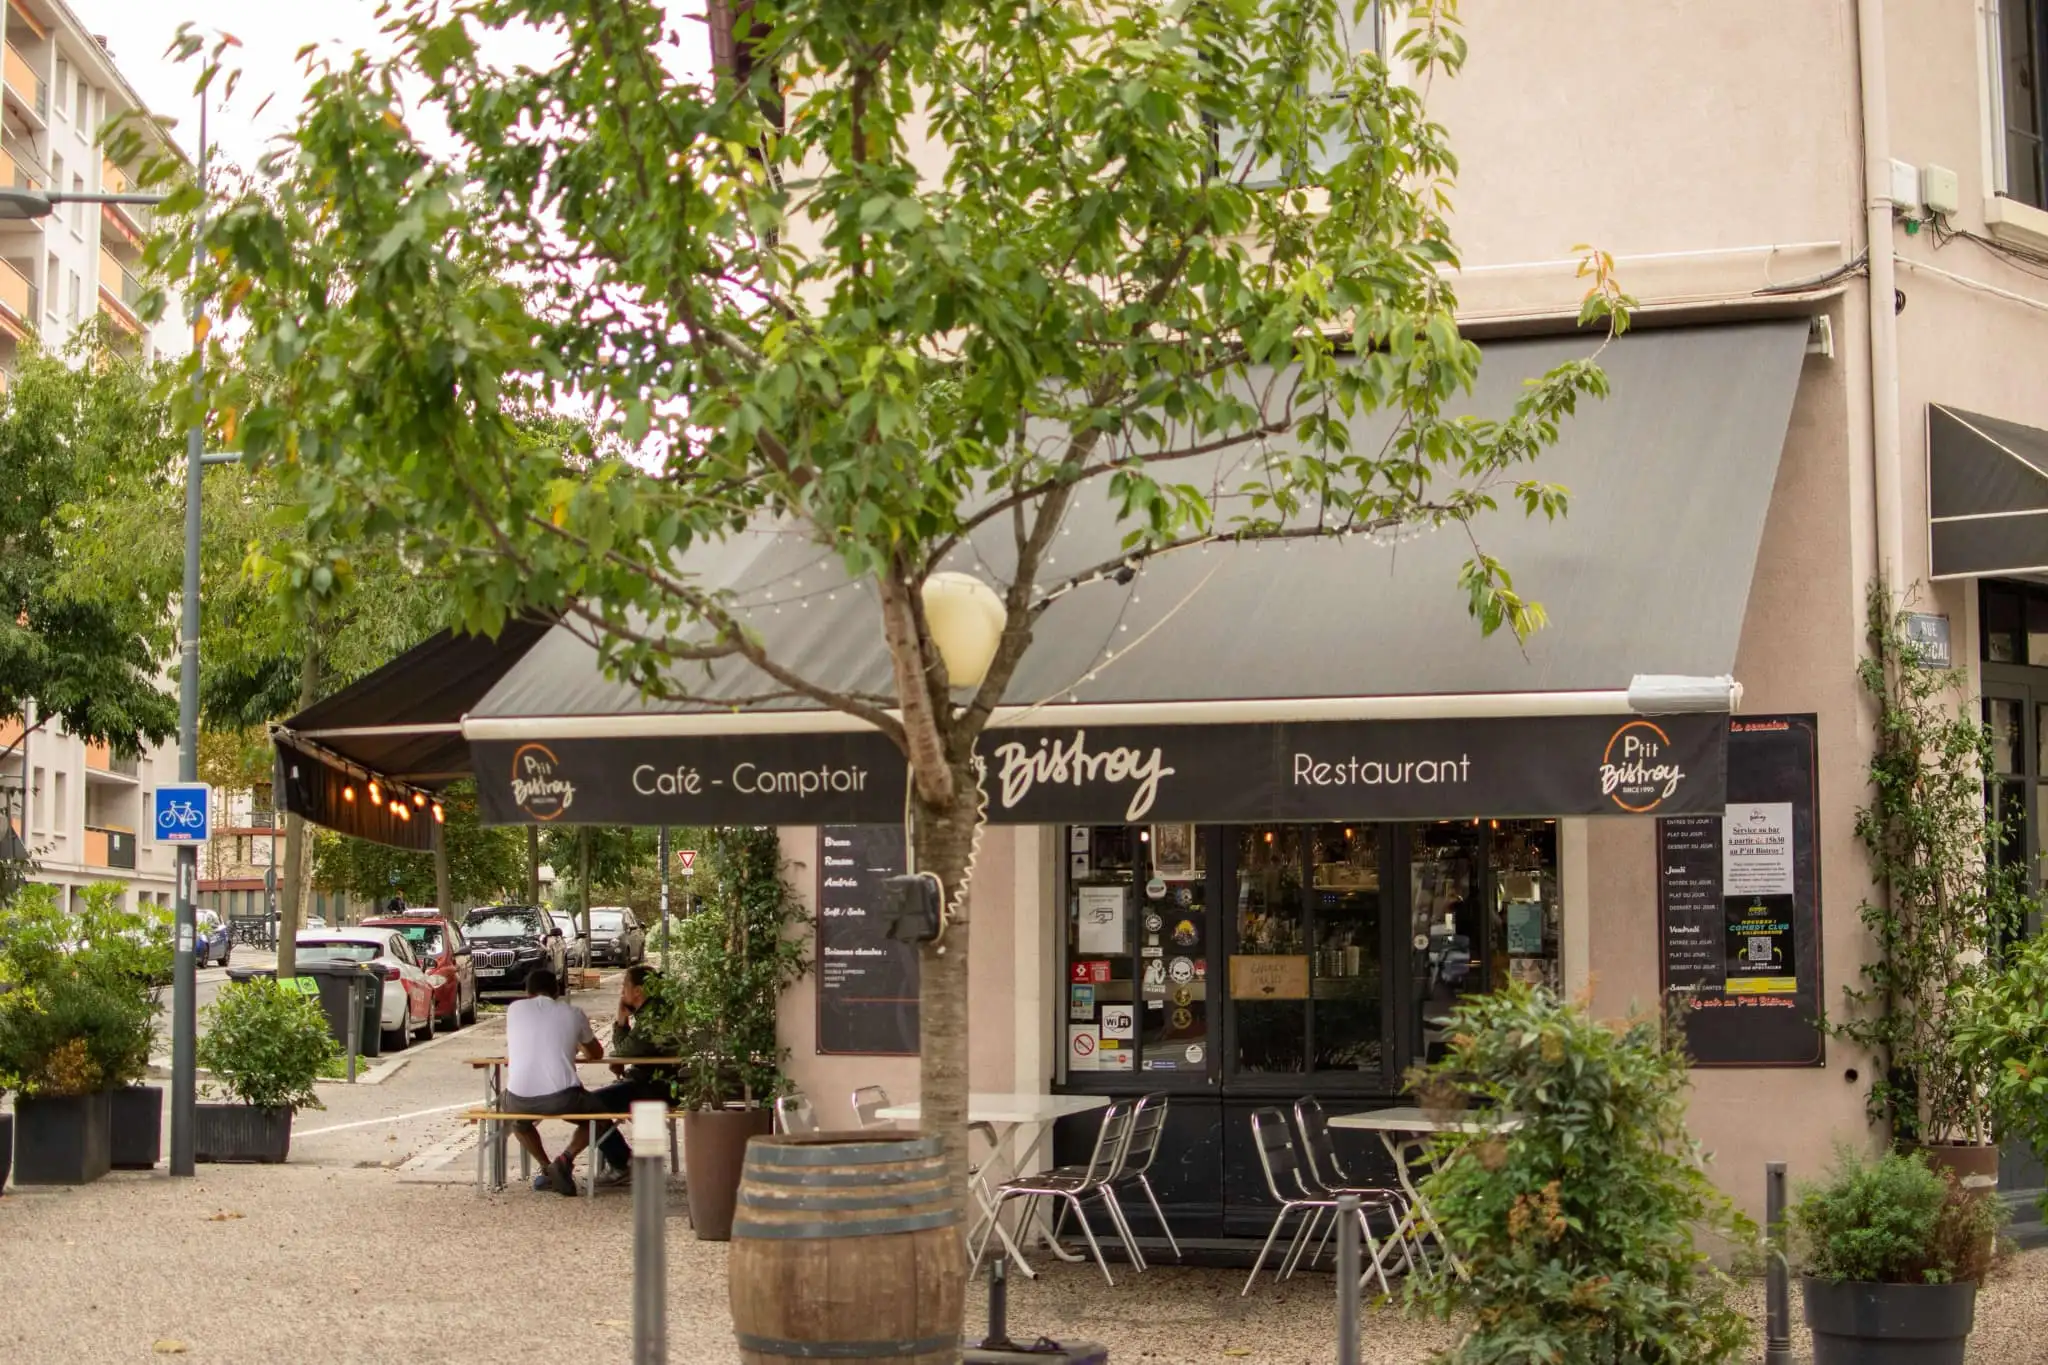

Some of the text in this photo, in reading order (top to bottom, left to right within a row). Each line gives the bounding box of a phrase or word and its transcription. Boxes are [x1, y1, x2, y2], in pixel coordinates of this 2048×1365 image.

[632, 763, 702, 797] Café
[732, 763, 868, 798] Comptoir
[994, 730, 1176, 822] Bistroy
[1294, 752, 1471, 786] Restaurant
[1600, 759, 1686, 799] Bistroy
[511, 775, 576, 809] Bistroy
